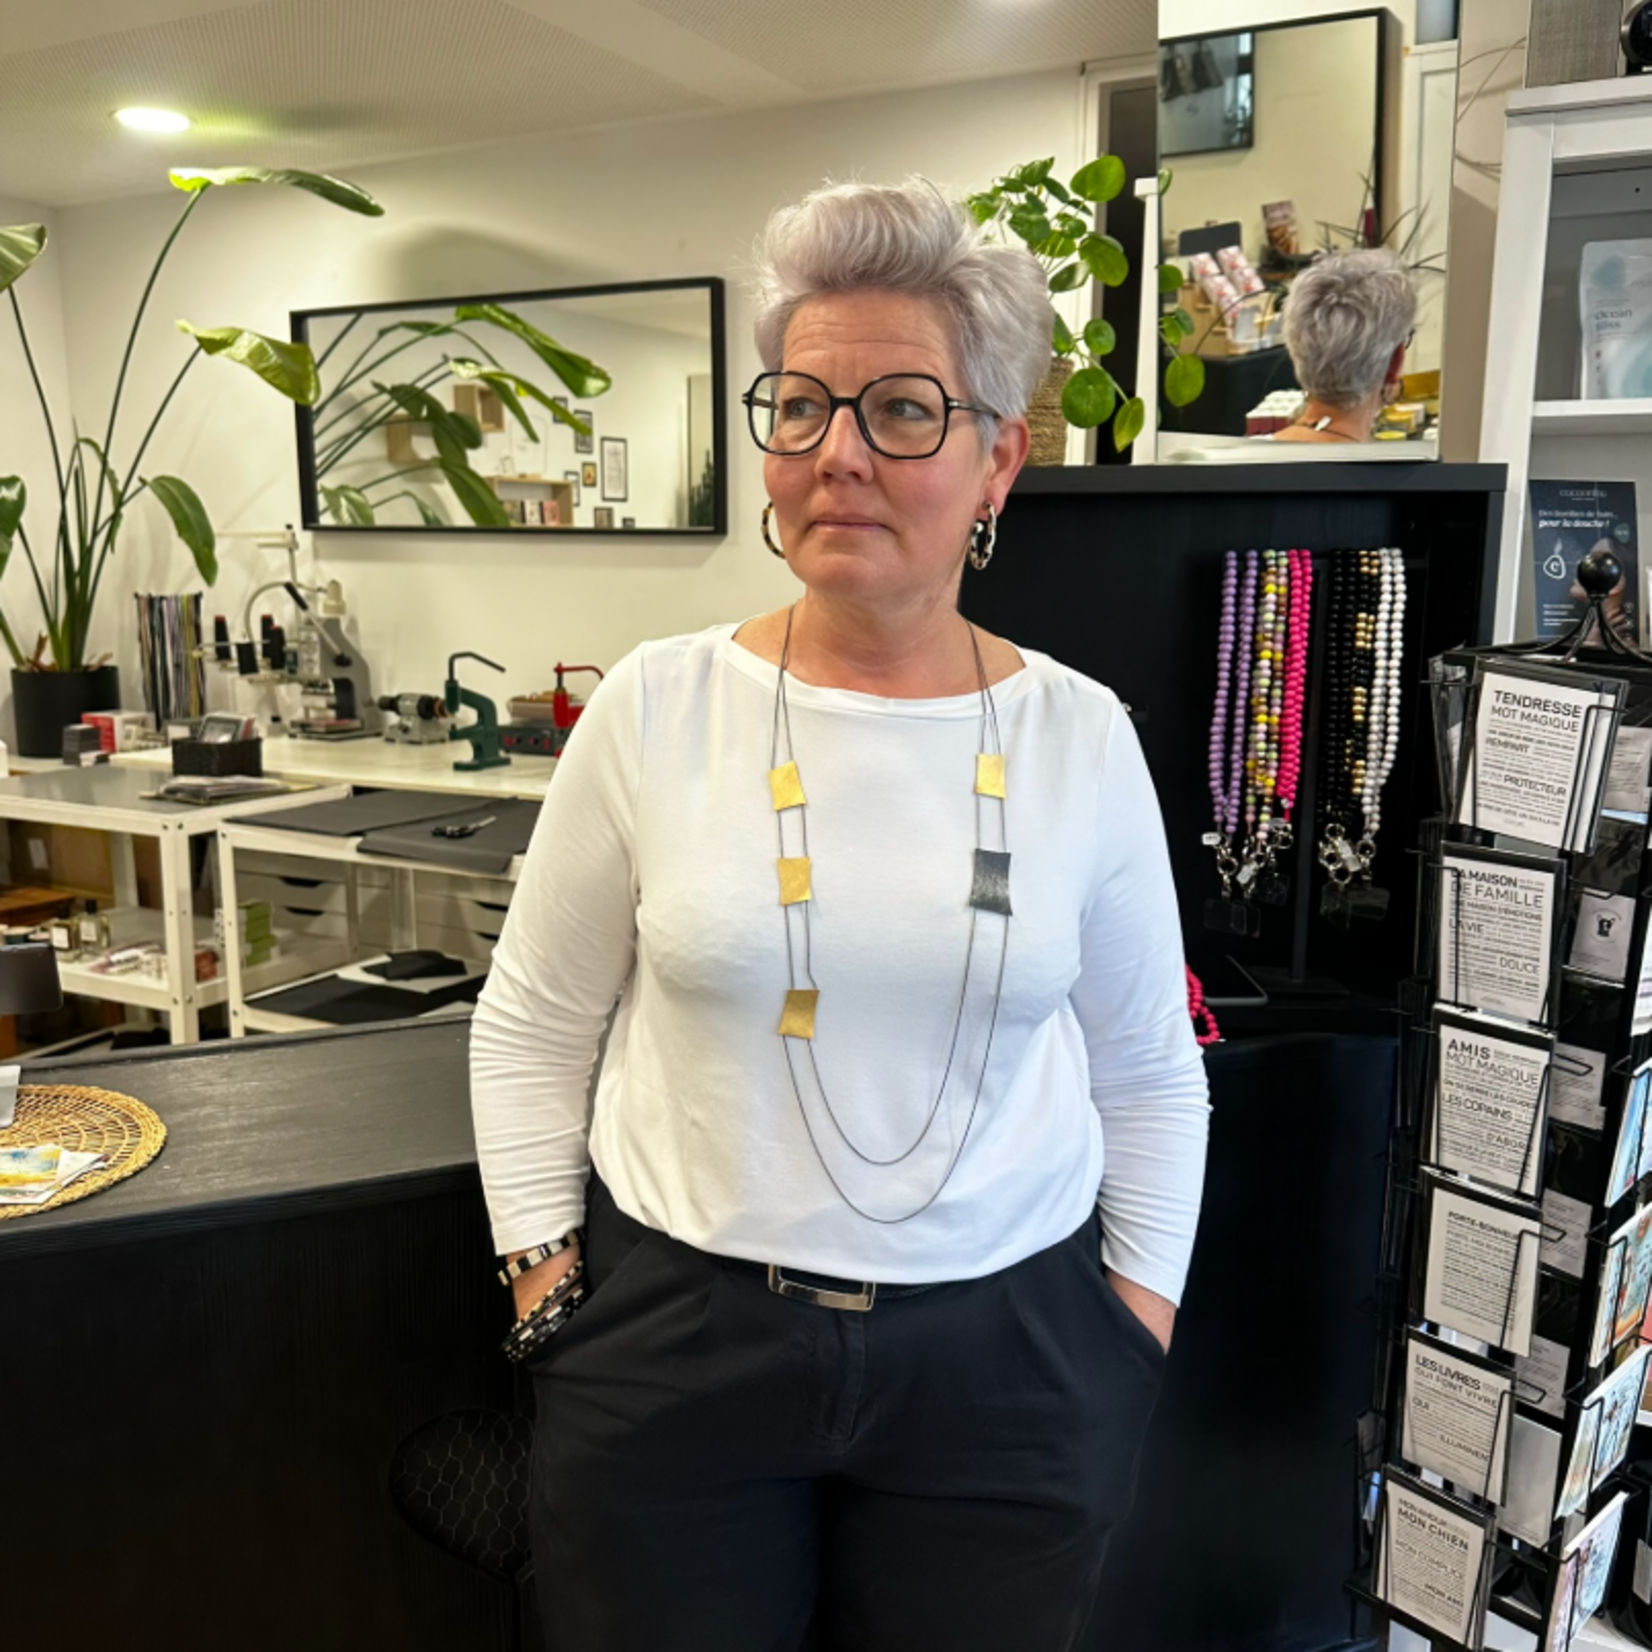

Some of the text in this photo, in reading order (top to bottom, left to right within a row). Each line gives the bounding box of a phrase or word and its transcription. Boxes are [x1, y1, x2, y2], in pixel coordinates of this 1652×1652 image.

[1493, 690, 1582, 718] TENDRESSE
[1490, 705, 1579, 732] MOT MAGIQUE
[1503, 773, 1567, 797] PROTECTEUR
[1468, 869, 1518, 888] MAISON
[1475, 884, 1544, 909] FAMILLE
[1499, 956, 1541, 975] DOUCE
[1447, 1038, 1491, 1060] AMIS
[1445, 1050, 1475, 1069] MOT
[1476, 1059, 1540, 1086] MAGIQUE
[1414, 1366, 1434, 1381] QUI
[1415, 1354, 1438, 1372] LES
[1438, 1364, 1481, 1391] LIVRES
[1397, 1507, 1426, 1529] MON
[1428, 1523, 1469, 1551] CHIEN
